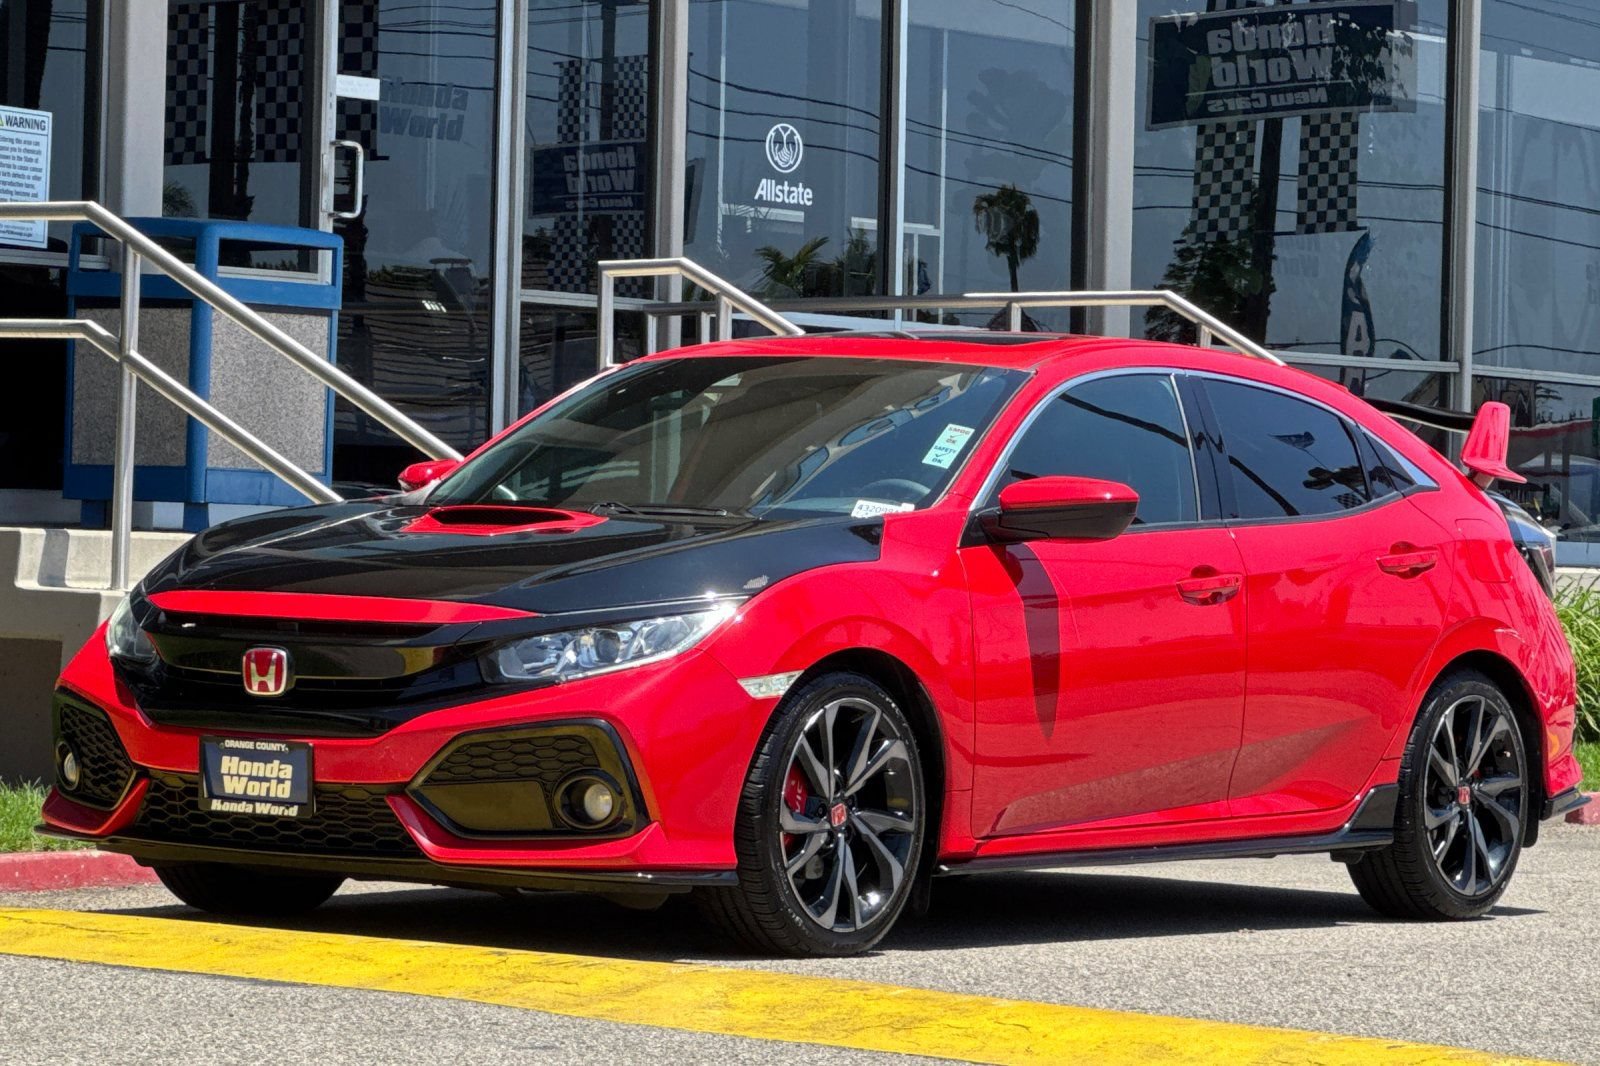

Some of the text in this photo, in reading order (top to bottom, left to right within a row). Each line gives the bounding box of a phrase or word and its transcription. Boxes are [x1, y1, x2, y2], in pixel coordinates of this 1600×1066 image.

[5, 115, 47, 131] WARNING
[380, 106, 465, 141] World
[754, 178, 813, 206] Allstate
[224, 740, 286, 752] ORANGE COUNTY
[220, 755, 293, 779] Honda
[222, 774, 292, 798] World
[210, 799, 253, 813] Honda
